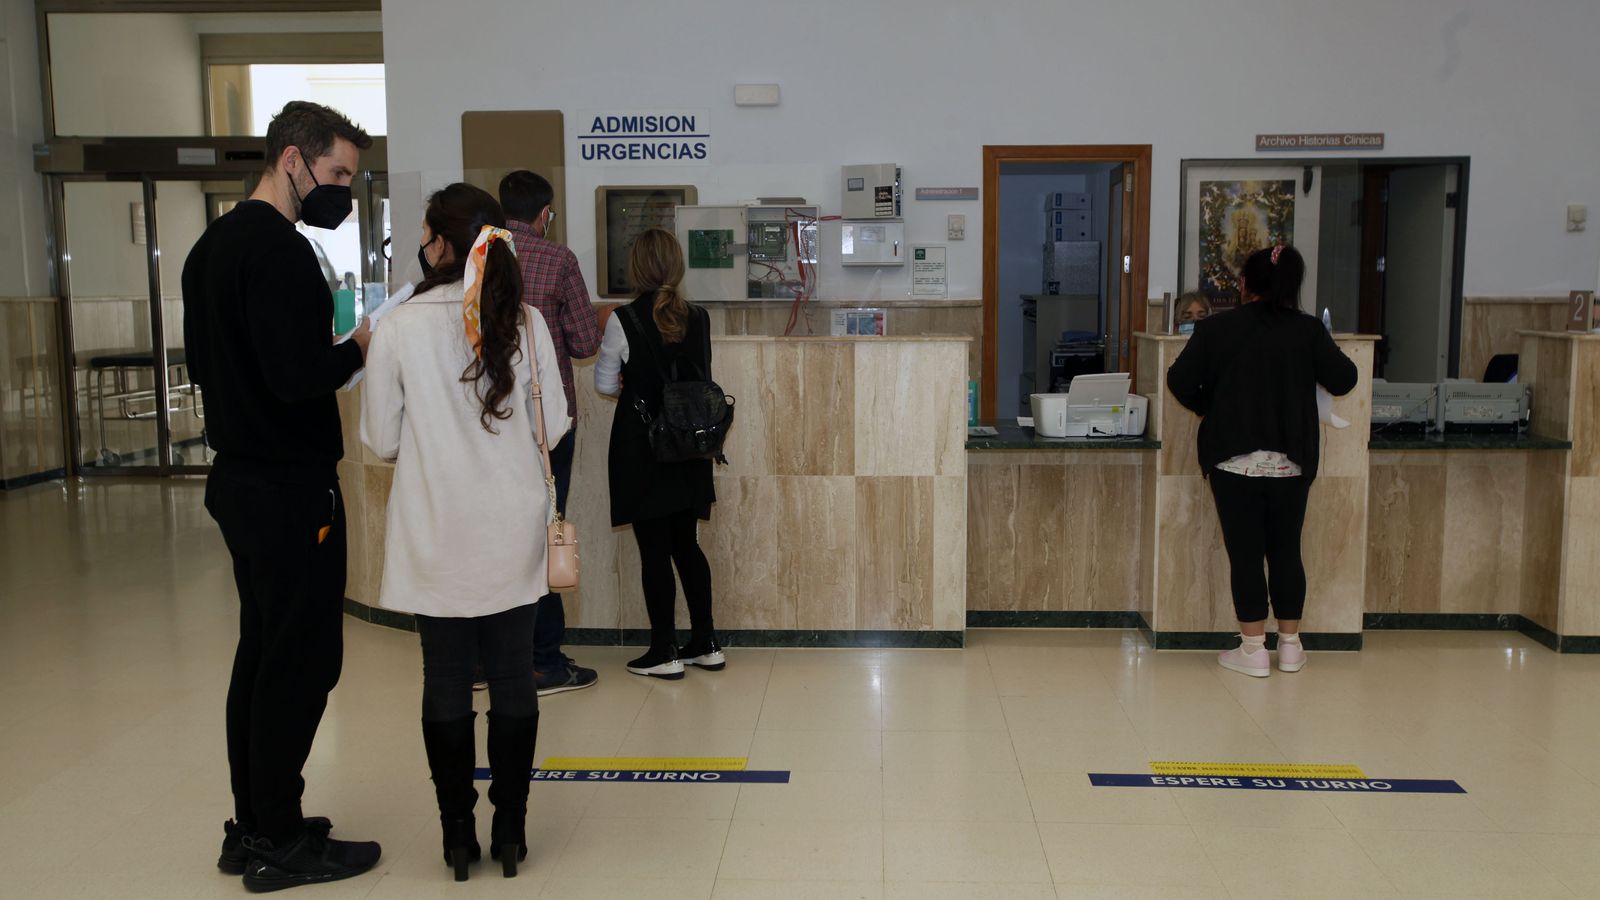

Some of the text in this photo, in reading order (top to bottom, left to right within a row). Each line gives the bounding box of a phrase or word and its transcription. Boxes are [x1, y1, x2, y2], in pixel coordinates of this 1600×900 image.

[591, 116, 695, 133] ADMISION
[1260, 136, 1296, 146] Archivo
[1299, 135, 1340, 145] Historias
[582, 143, 707, 160] URGENCIAS
[1573, 294, 1584, 321] 2
[587, 771, 620, 780] SU
[632, 772, 721, 781] TURNO
[1151, 776, 1392, 790] ESPERE SU TURNO
